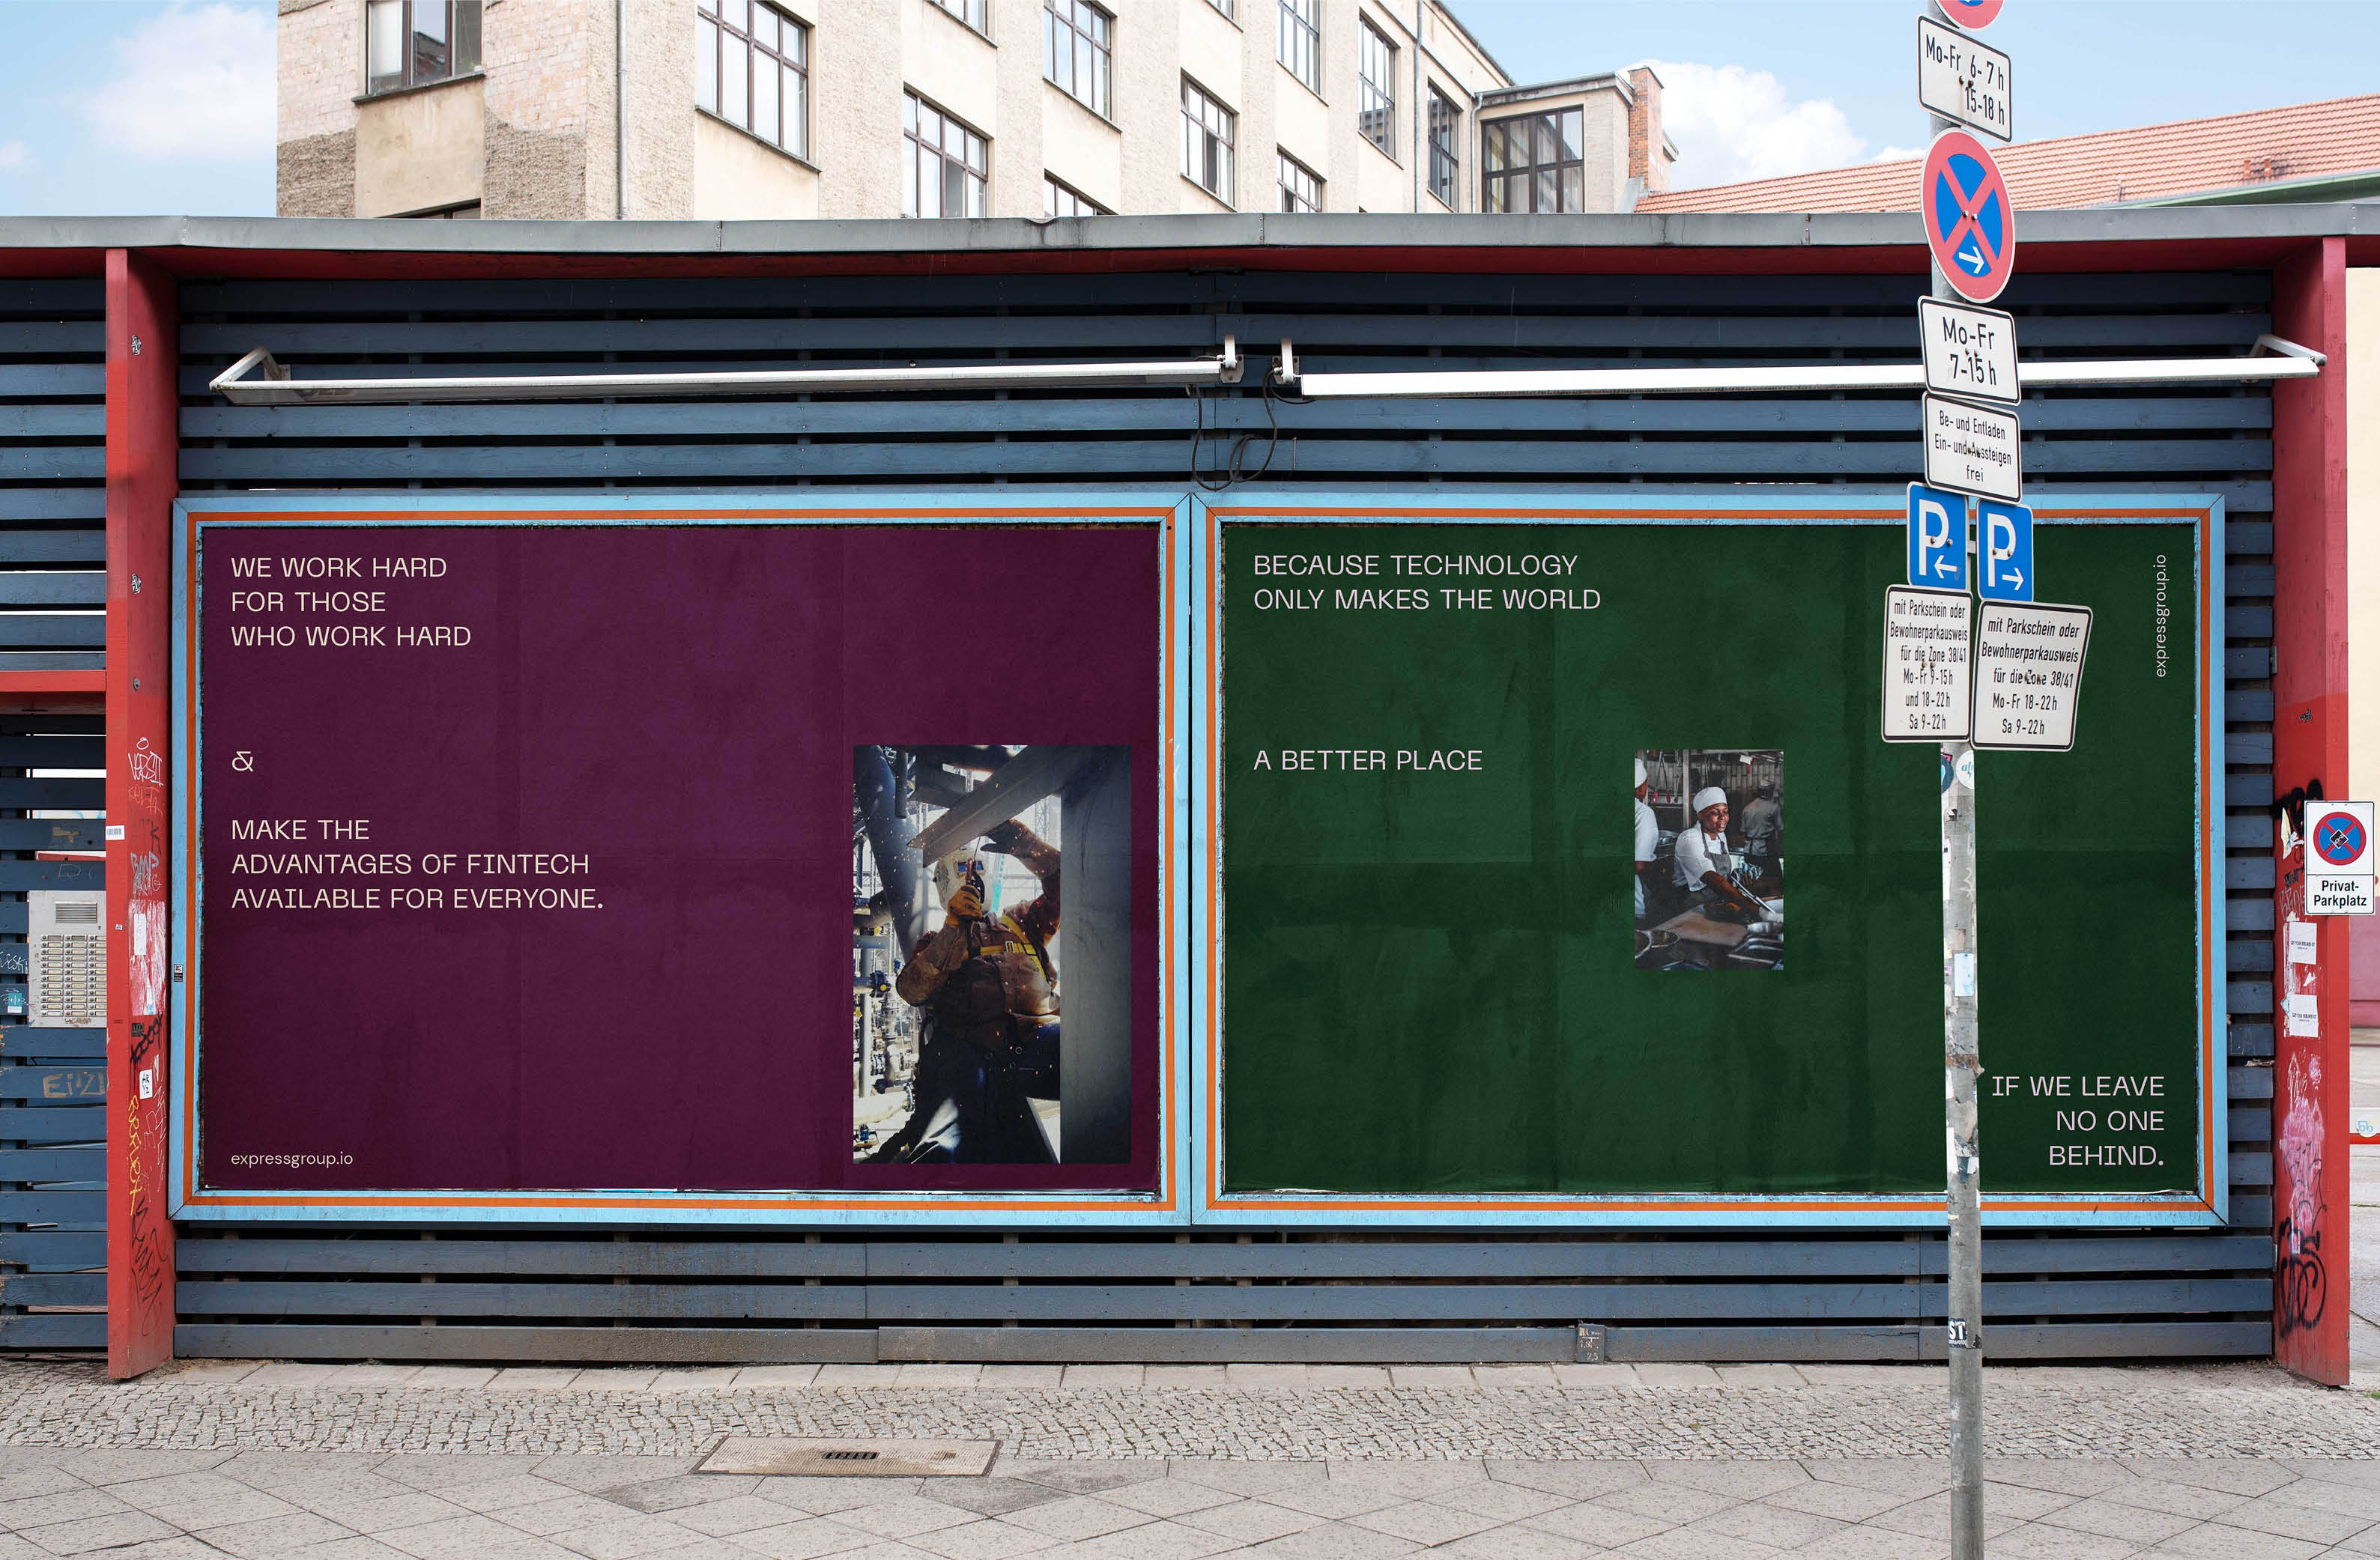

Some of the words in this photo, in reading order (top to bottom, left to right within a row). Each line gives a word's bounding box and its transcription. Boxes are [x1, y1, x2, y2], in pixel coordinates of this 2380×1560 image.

[1926, 34, 1961, 71] Mo-Fr
[1943, 317, 1994, 350] Mo-Fr
[1940, 410, 1954, 427] Be-
[1956, 416, 1969, 431] und
[1973, 418, 2005, 440] Entladen
[1935, 434, 1951, 451] Ein-
[1954, 440, 1967, 455] und
[1972, 442, 2011, 467] Aussteigen
[1966, 465, 1984, 482] frei
[231, 557, 271, 577] WE
[282, 557, 362, 577] WORK
[373, 558, 446, 577] HARD
[1255, 555, 1379, 575] BECAUSE
[1390, 555, 1578, 575] TECHNOLOGY
[232, 592, 283, 612] FOR
[295, 592, 385, 612] THOSE
[1255, 589, 1324, 610] ONLY
[1336, 589, 1429, 610] MAKES
[1440, 589, 1492, 609] THE
[1503, 589, 1600, 609] WORLD
[1894, 599, 1906, 615] mit
[1910, 599, 1947, 618] Parkschein
[1950, 603, 1965, 619] oder
[2153, 554, 2169, 678] expressgroup.io
[231, 626, 295, 646] WHO
[306, 626, 386, 646] WORK
[398, 627, 470, 646] HARD
[1890, 622, 1968, 643] Bewohnerparkausweis
[1988, 617, 2002, 632] mit
[2006, 618, 2055, 637] Parkschein
[2059, 623, 2080, 638] oder
[1901, 645, 1911, 661] für
[1915, 646, 1925, 662] die
[1928, 646, 1945, 663] Zone
[1948, 647, 1966, 664] 38/41
[1981, 641, 2079, 664] Bewohnerparkausweis
[1993, 668, 2006, 684] für
[2011, 669, 2023, 685] die
[2026, 670, 2047, 685] Zone
[2050, 671, 2074, 688] 38/41
[1905, 691, 1919, 707] und
[1910, 714, 1918, 729] Sa
[2002, 718, 2012, 733] Sa
[231, 750, 254, 772] &
[1254, 750, 1271, 770] A
[1283, 750, 1385, 770] BETTER
[1397, 750, 1482, 770] PLACE
[232, 820, 306, 839] MAKE
[318, 820, 369, 839] THE
[231, 854, 411, 874] ADVANTAGES
[423, 854, 457, 874] OF
[468, 854, 588, 874] FINTECH
[2322, 881, 2359, 891] Privat-
[231, 889, 381, 908] AVAILABLE
[391, 888, 442, 908] FOR
[454, 888, 603, 908] EVERYONE.
[2313, 894, 2367, 909] Parkplatz
[1993, 1076, 2020, 1096] IF
[2030, 1076, 2071, 1096] WE
[2083, 1076, 2164, 1096] LEAVE
[2057, 1111, 2096, 1131] NO
[2108, 1111, 2164, 1131] ONE
[231, 1151, 354, 1168] expressgroup.io
[2050, 1146, 2164, 1166] BEHIND.
